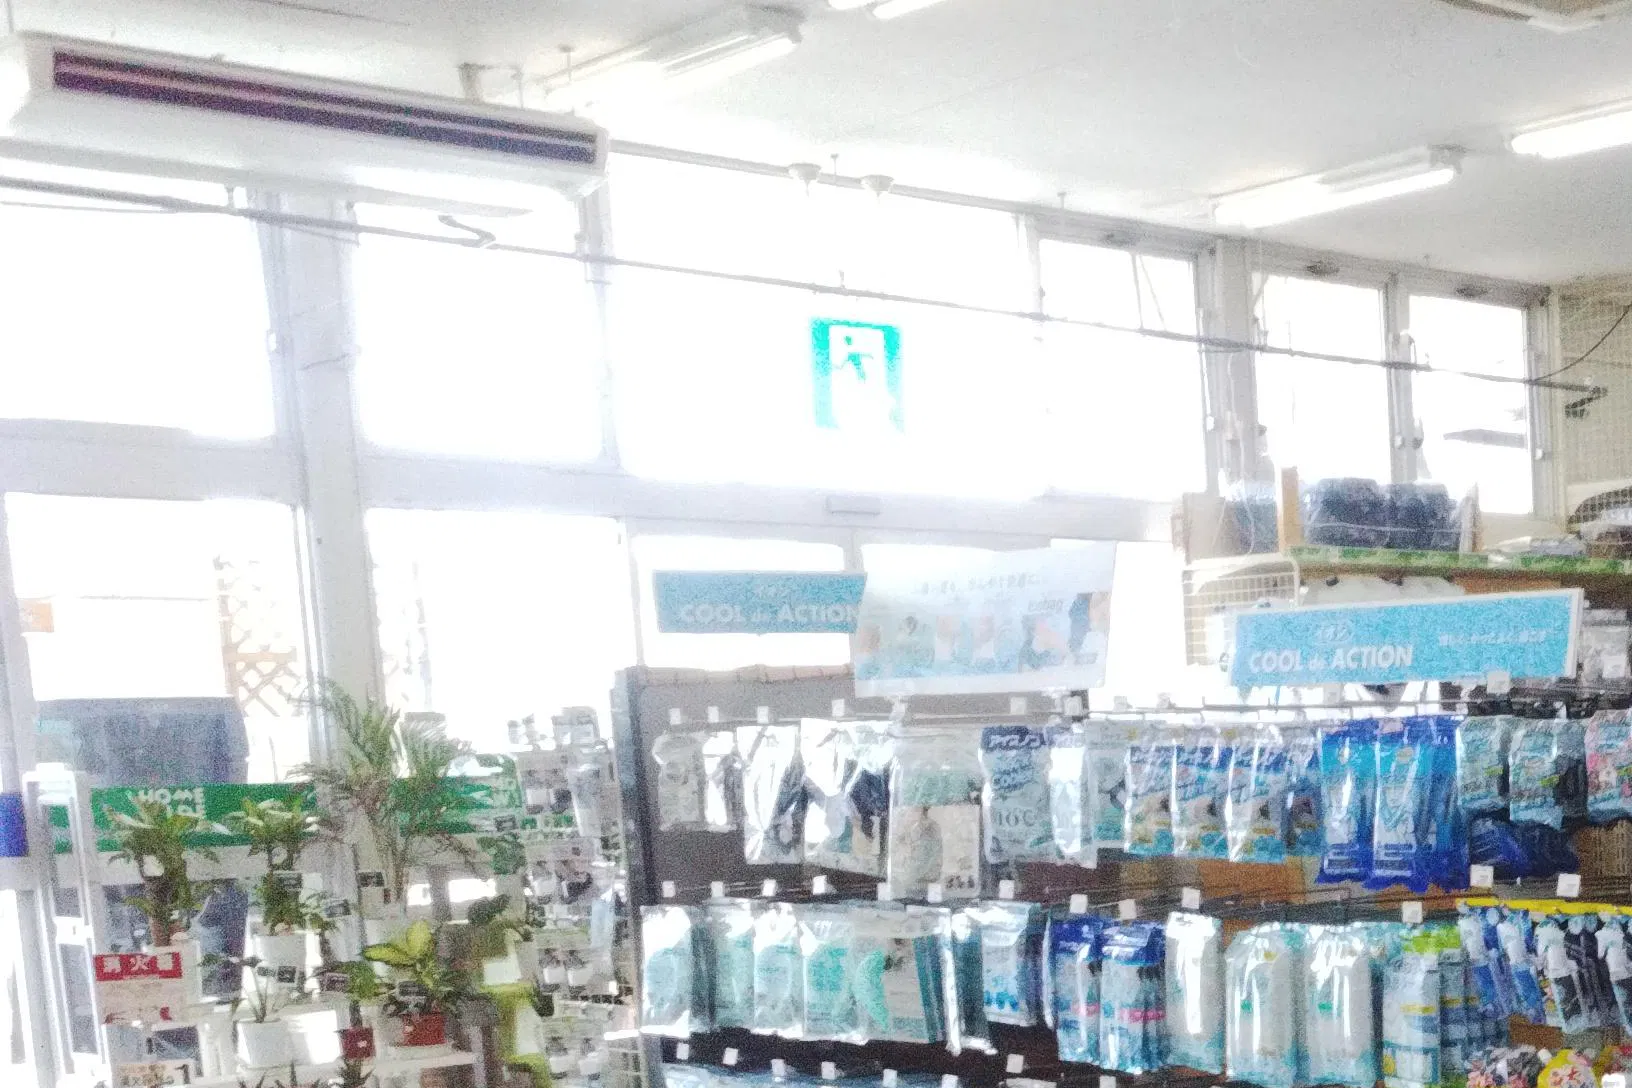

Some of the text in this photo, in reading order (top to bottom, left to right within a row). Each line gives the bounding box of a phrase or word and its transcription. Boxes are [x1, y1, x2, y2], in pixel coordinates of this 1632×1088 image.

[679, 604, 744, 623] COOL
[1249, 648, 1301, 673] COOL
[1332, 645, 1414, 670] ACTION
